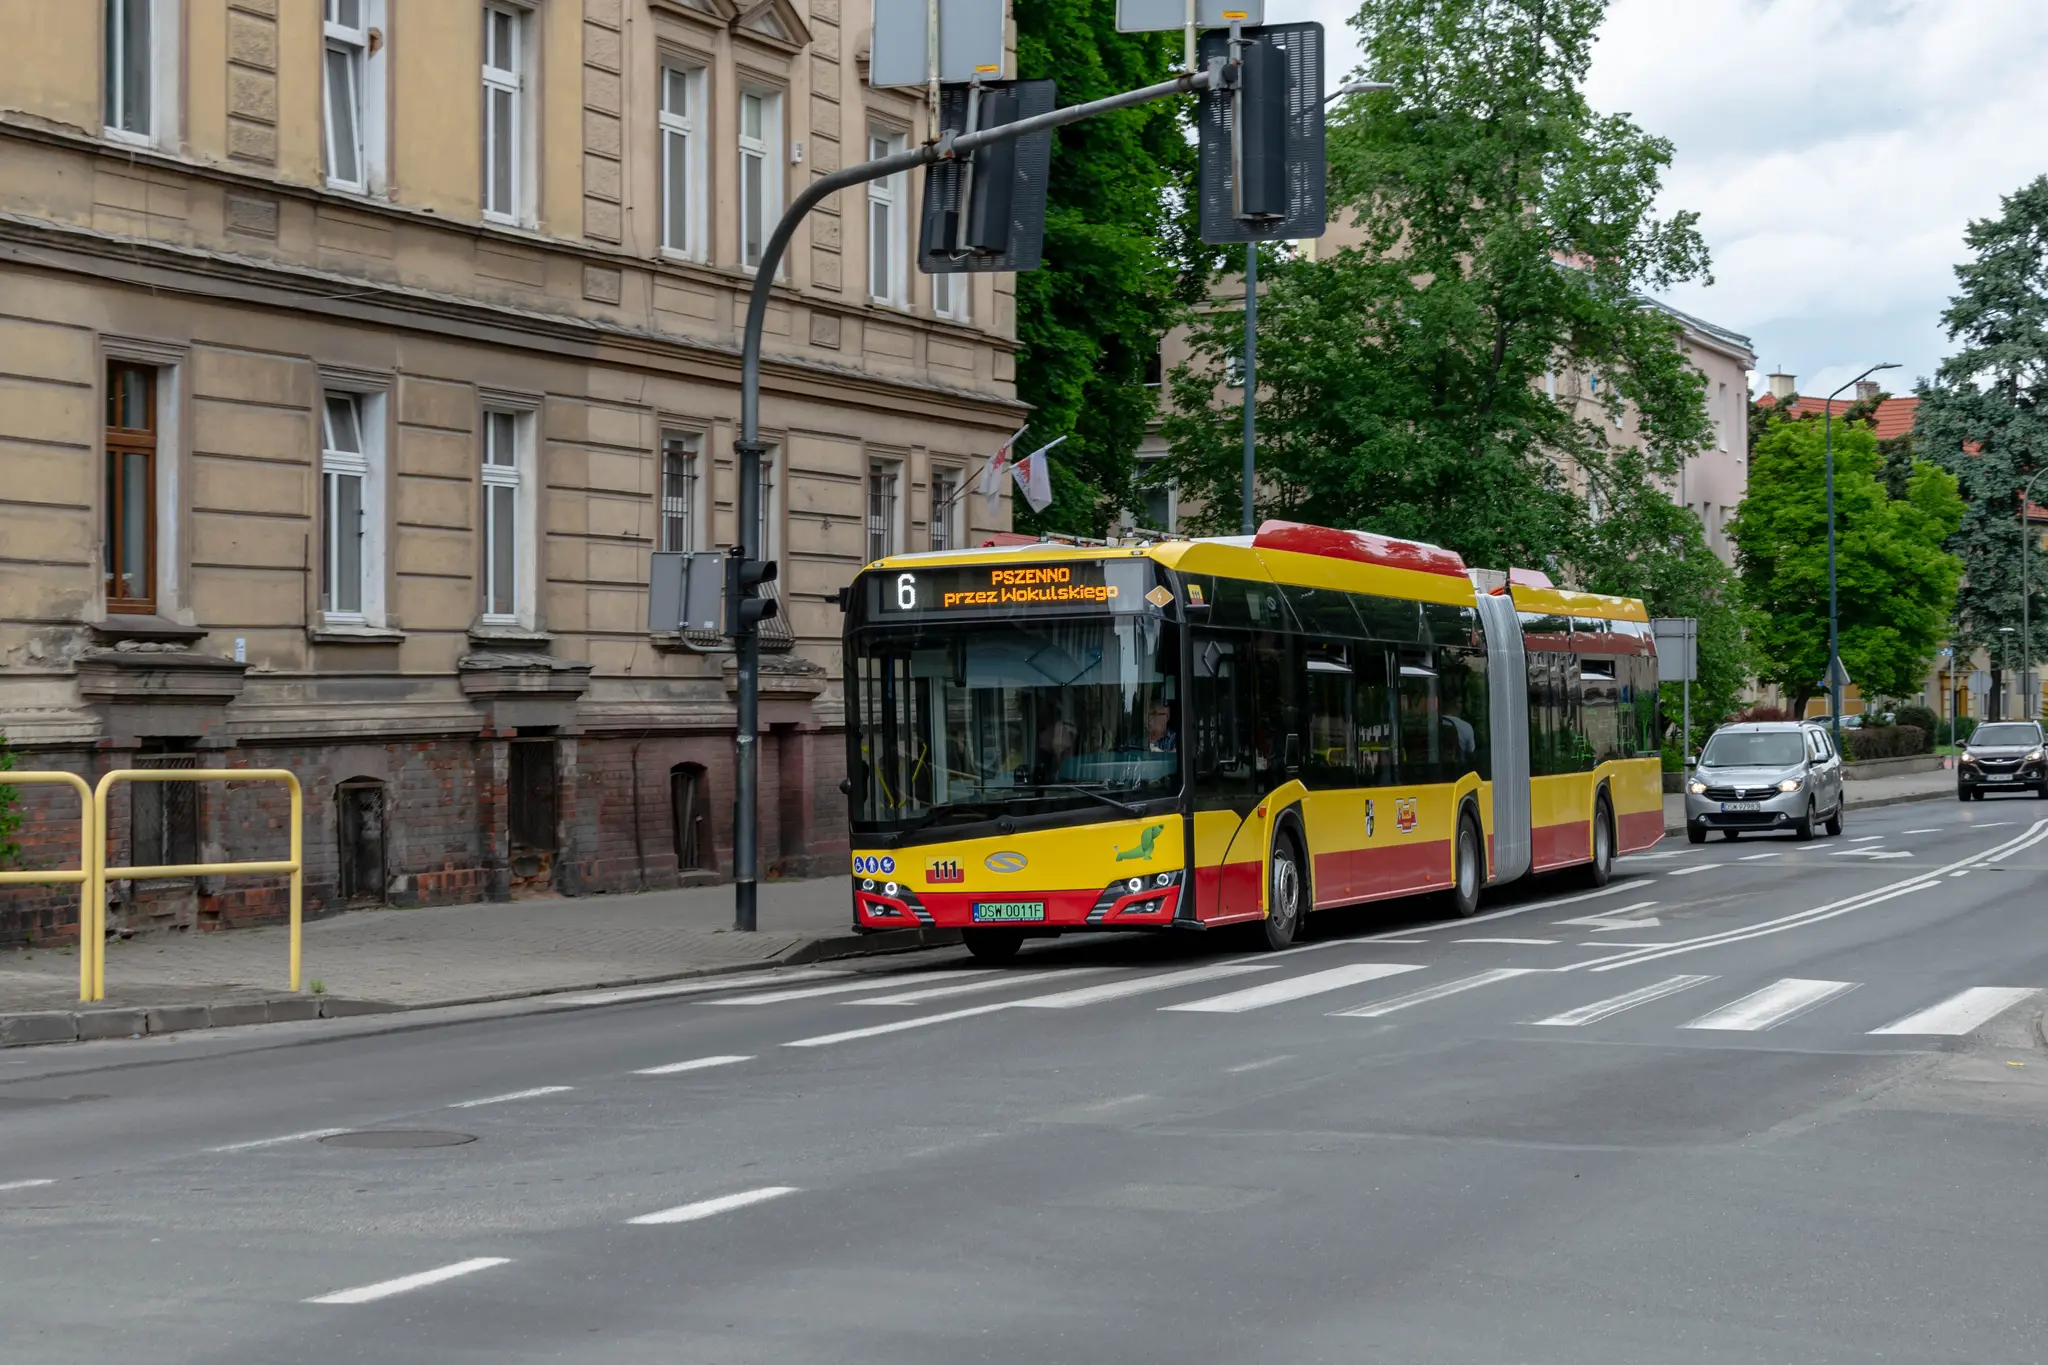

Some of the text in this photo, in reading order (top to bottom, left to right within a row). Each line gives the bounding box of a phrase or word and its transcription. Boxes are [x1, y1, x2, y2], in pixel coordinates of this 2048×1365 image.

[991, 567, 1070, 585] PSZENNO
[897, 573, 916, 610] 6
[944, 585, 1119, 607] przez Wokulskiego
[932, 860, 957, 879] 111
[980, 904, 1042, 918] DSW 0011F
